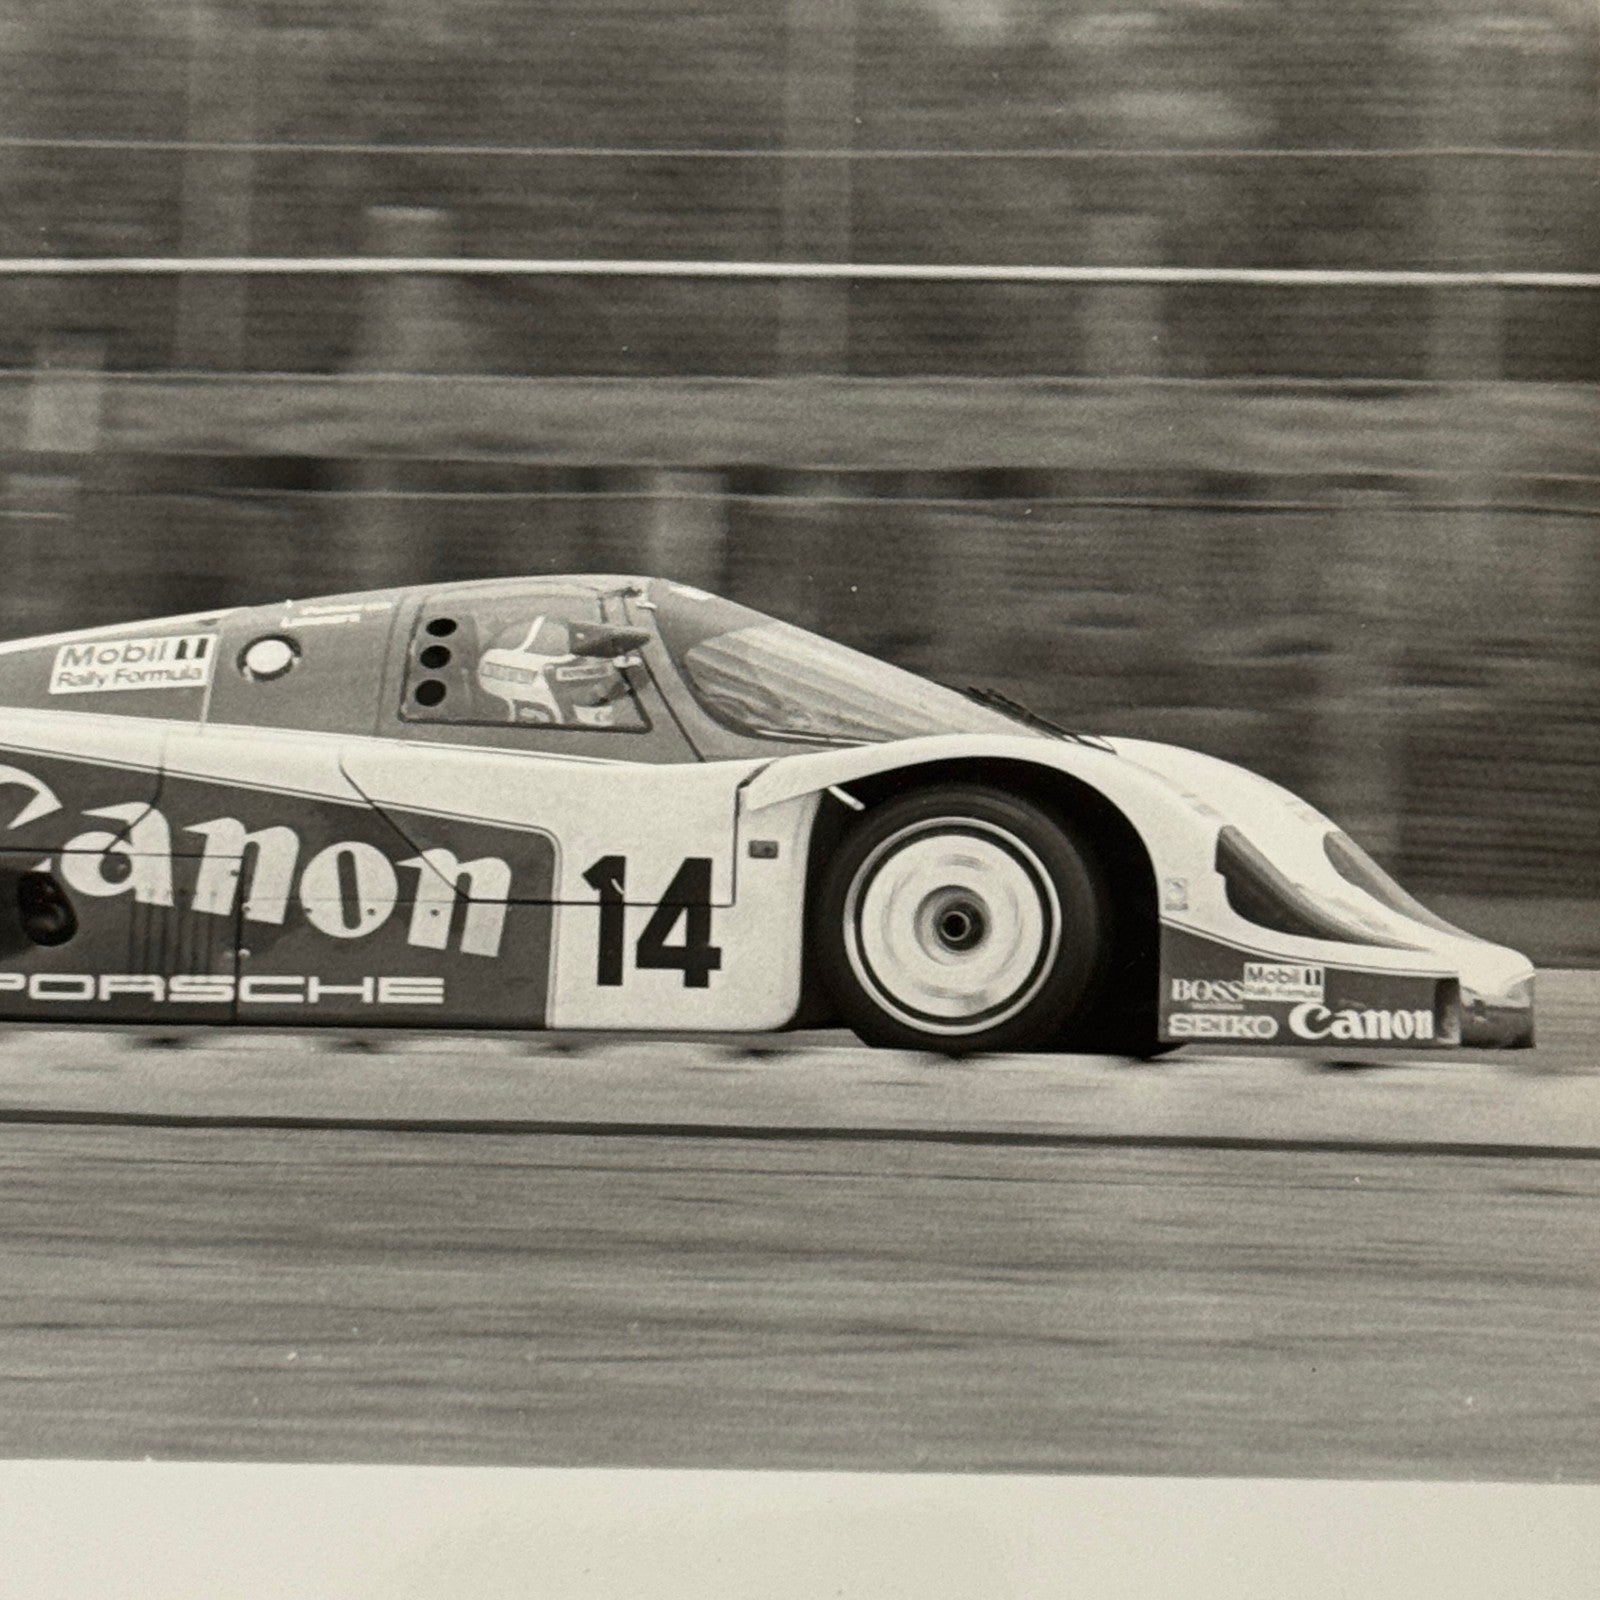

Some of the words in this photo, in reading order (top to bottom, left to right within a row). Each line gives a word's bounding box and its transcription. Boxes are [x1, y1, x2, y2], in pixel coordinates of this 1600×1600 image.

[62, 640, 168, 667] Mobil
[57, 669, 106, 687] Rally
[113, 665, 203, 684] Formula
[582, 855, 721, 988] 14
[1172, 978, 1245, 1001] BOSS
[1169, 1012, 1279, 1039] SEIKO
[1288, 1002, 1433, 1039] Canon
